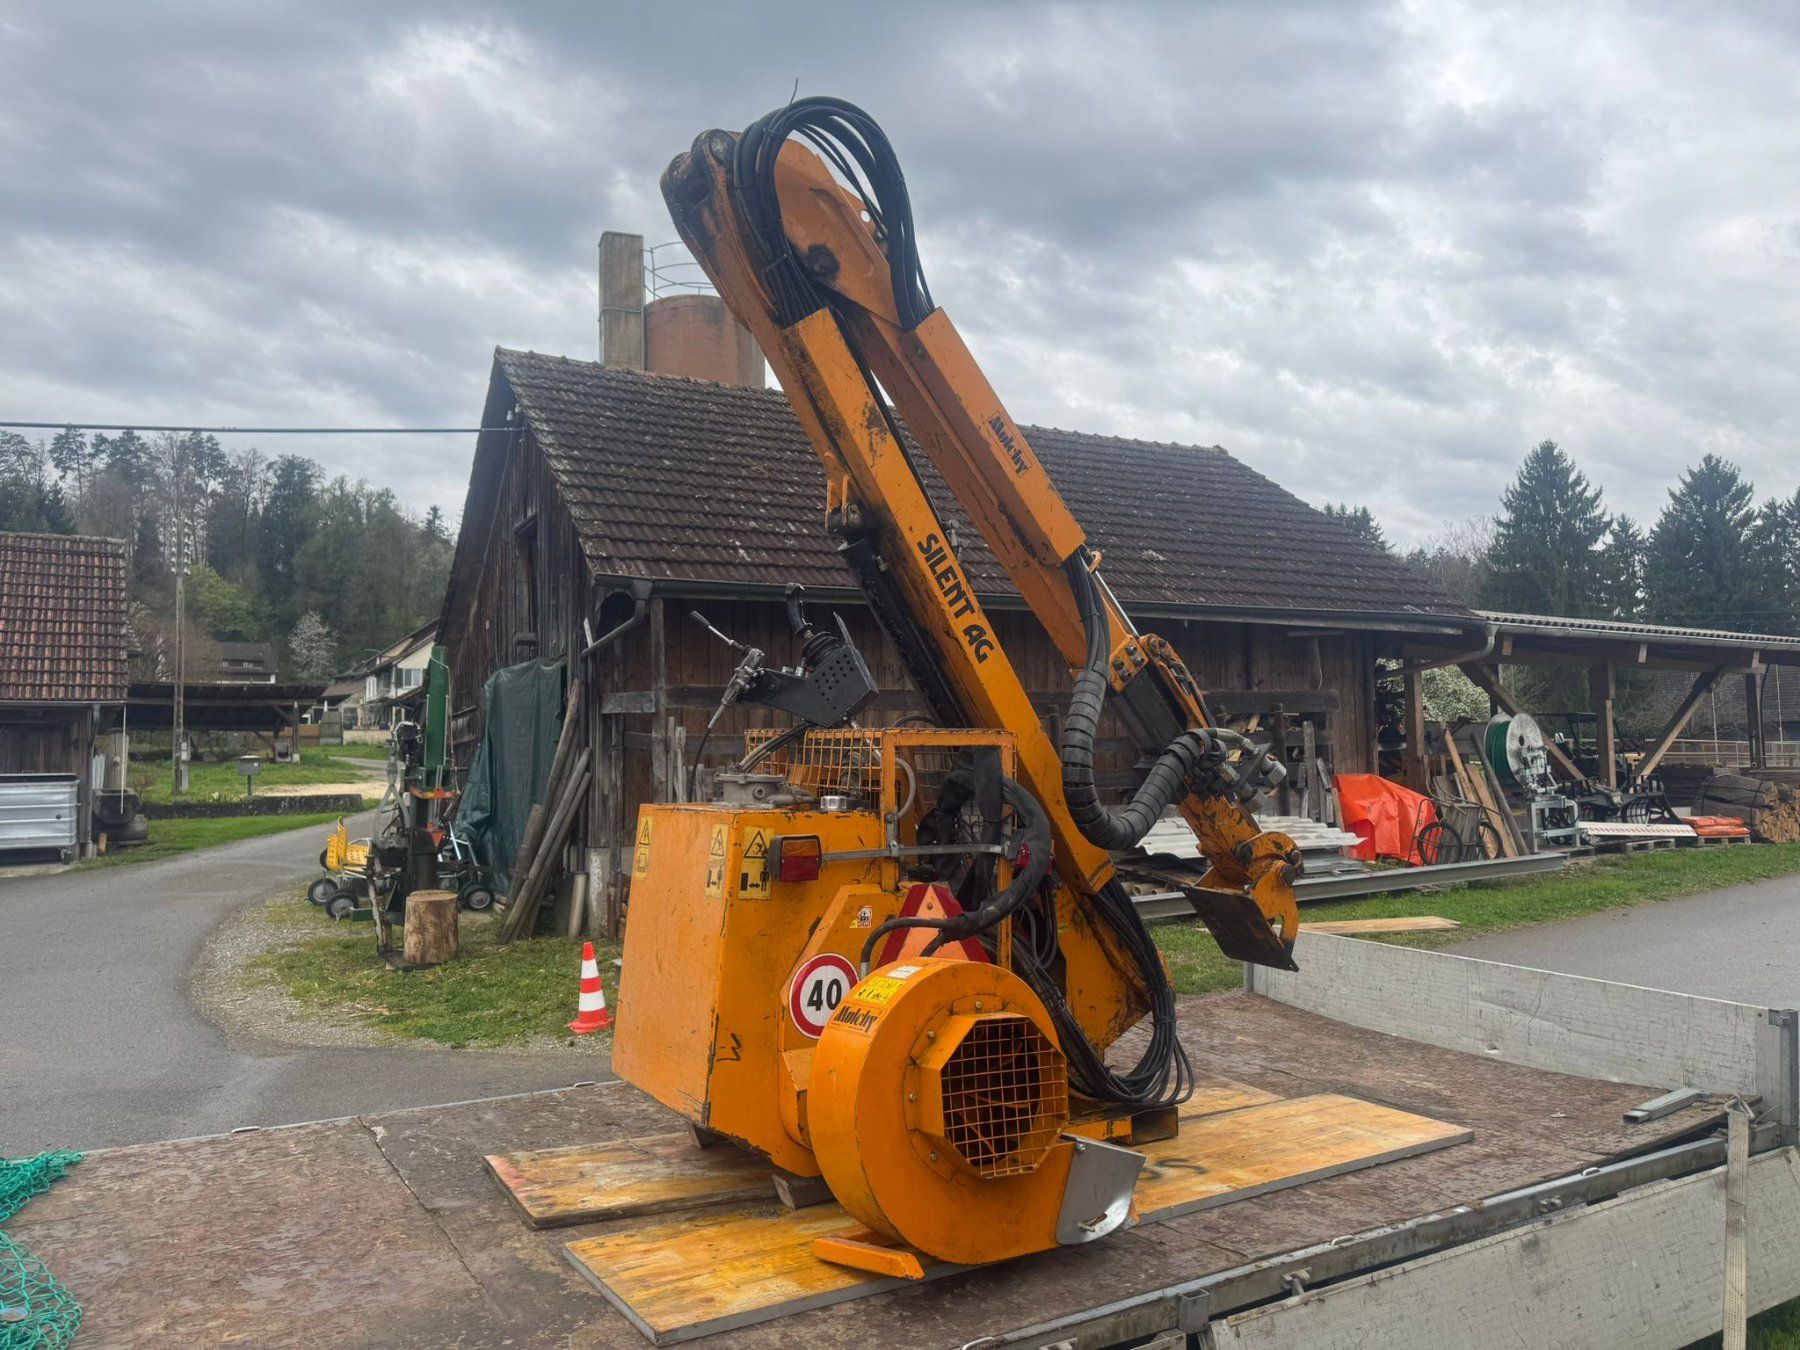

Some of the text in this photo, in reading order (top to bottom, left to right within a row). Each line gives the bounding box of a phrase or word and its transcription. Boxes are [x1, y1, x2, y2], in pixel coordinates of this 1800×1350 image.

[988, 416, 1028, 476] Mulchy
[917, 533, 995, 664] SILENT AG
[807, 978, 843, 1012] 40
[833, 1005, 879, 1034] Mulchy
